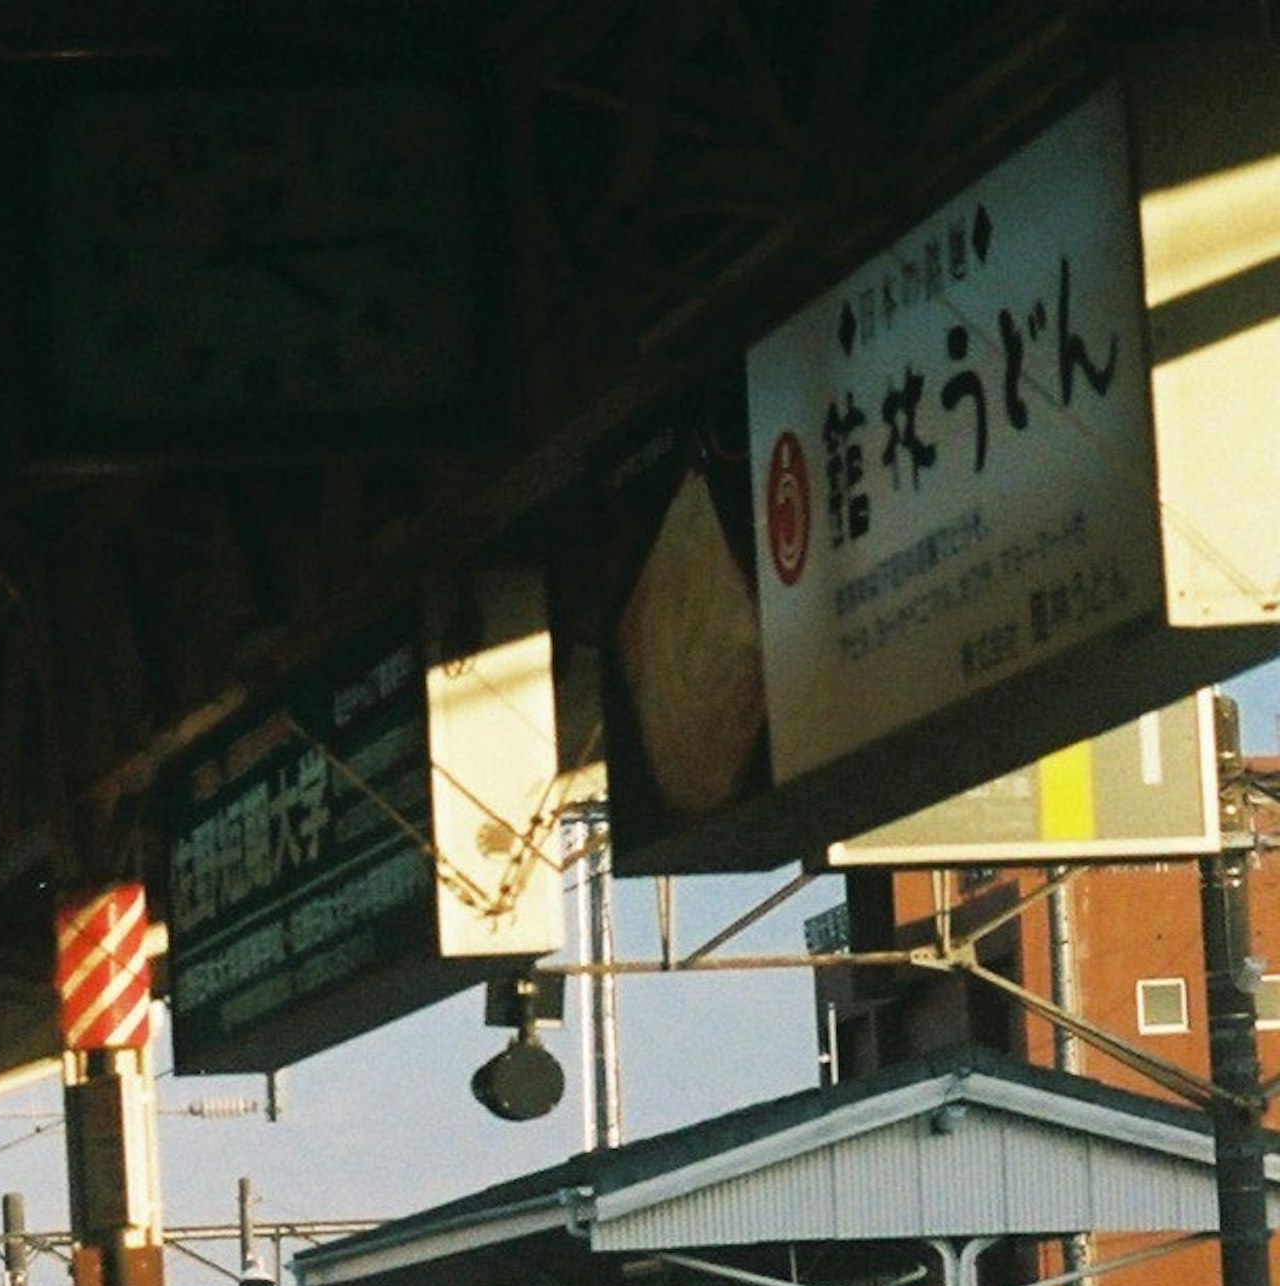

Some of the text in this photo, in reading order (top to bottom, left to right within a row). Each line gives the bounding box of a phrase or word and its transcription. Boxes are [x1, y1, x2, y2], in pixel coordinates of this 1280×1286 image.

[821, 255, 1117, 549] 館林うどん
